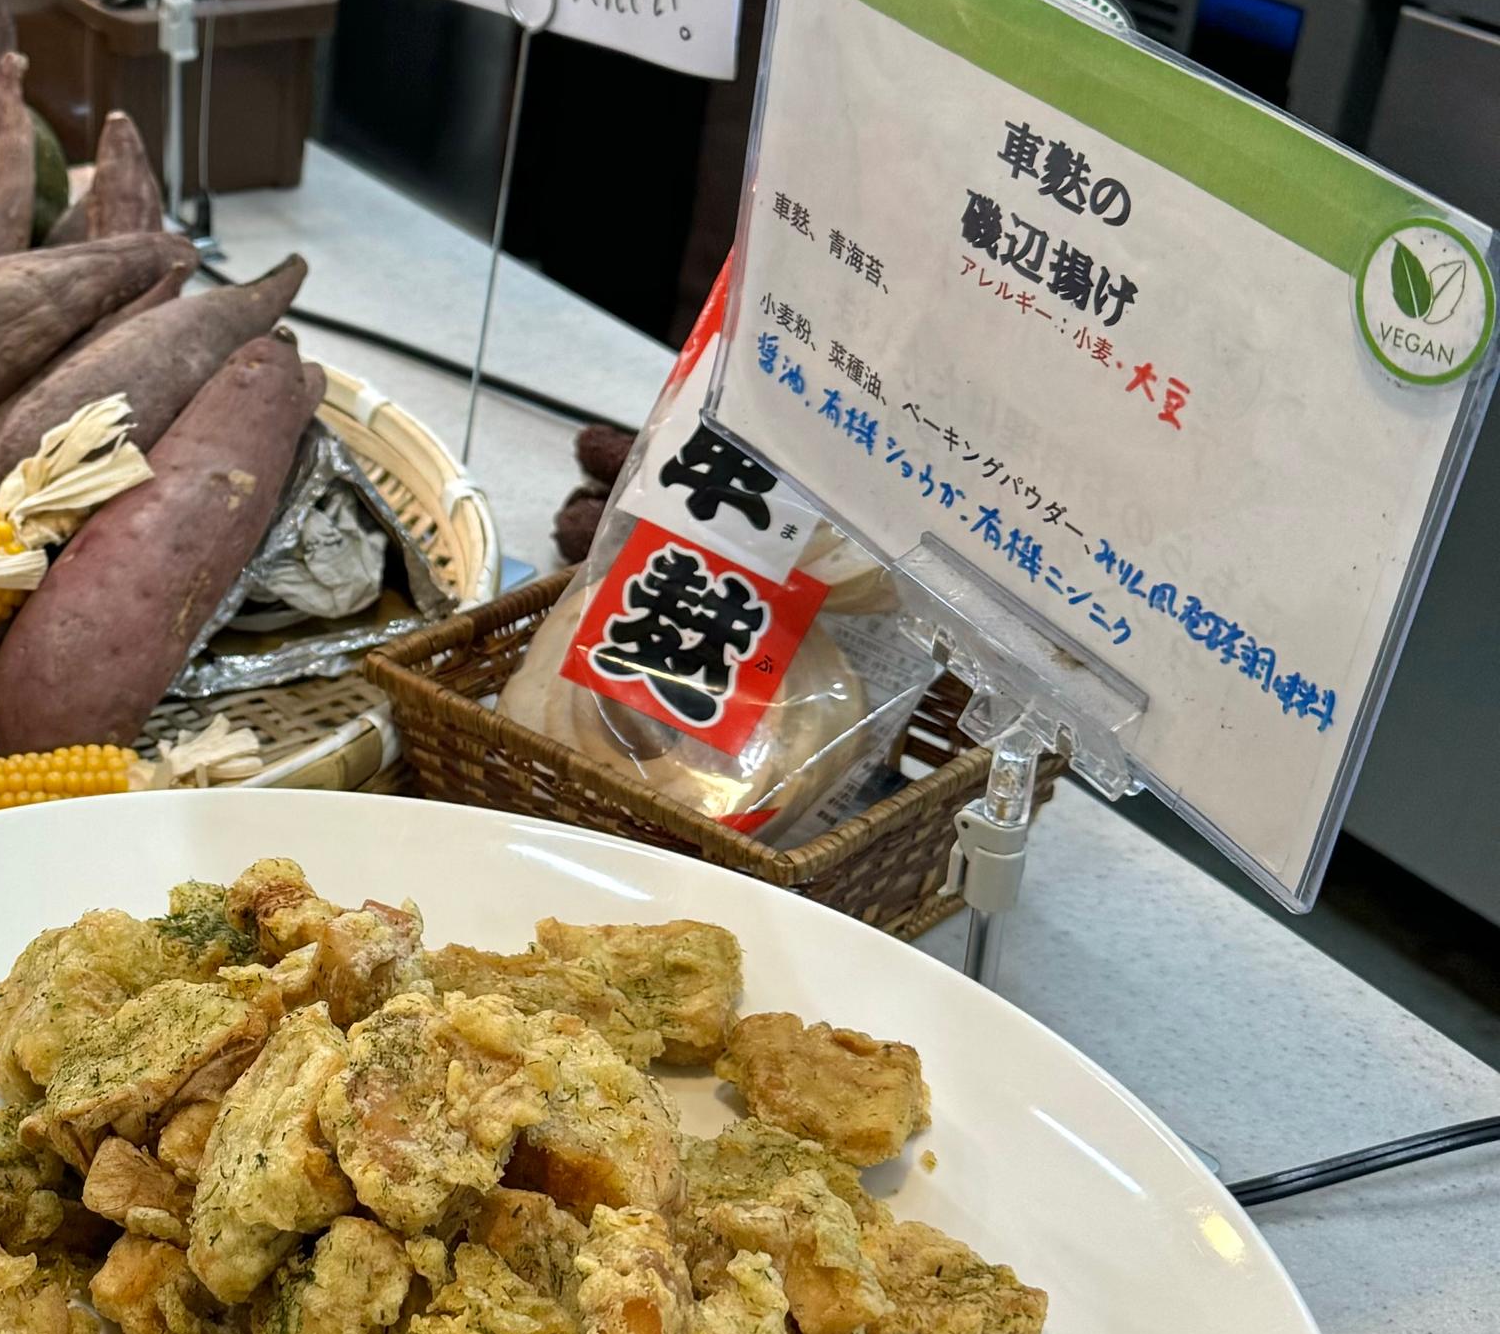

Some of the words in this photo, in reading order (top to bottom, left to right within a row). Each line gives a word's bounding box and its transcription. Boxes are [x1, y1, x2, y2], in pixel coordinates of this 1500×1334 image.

[997, 120, 1131, 227] 車麩の
[961, 188, 1139, 327] 磯辺揚げ
[1380, 322, 1455, 367] VEGAN
